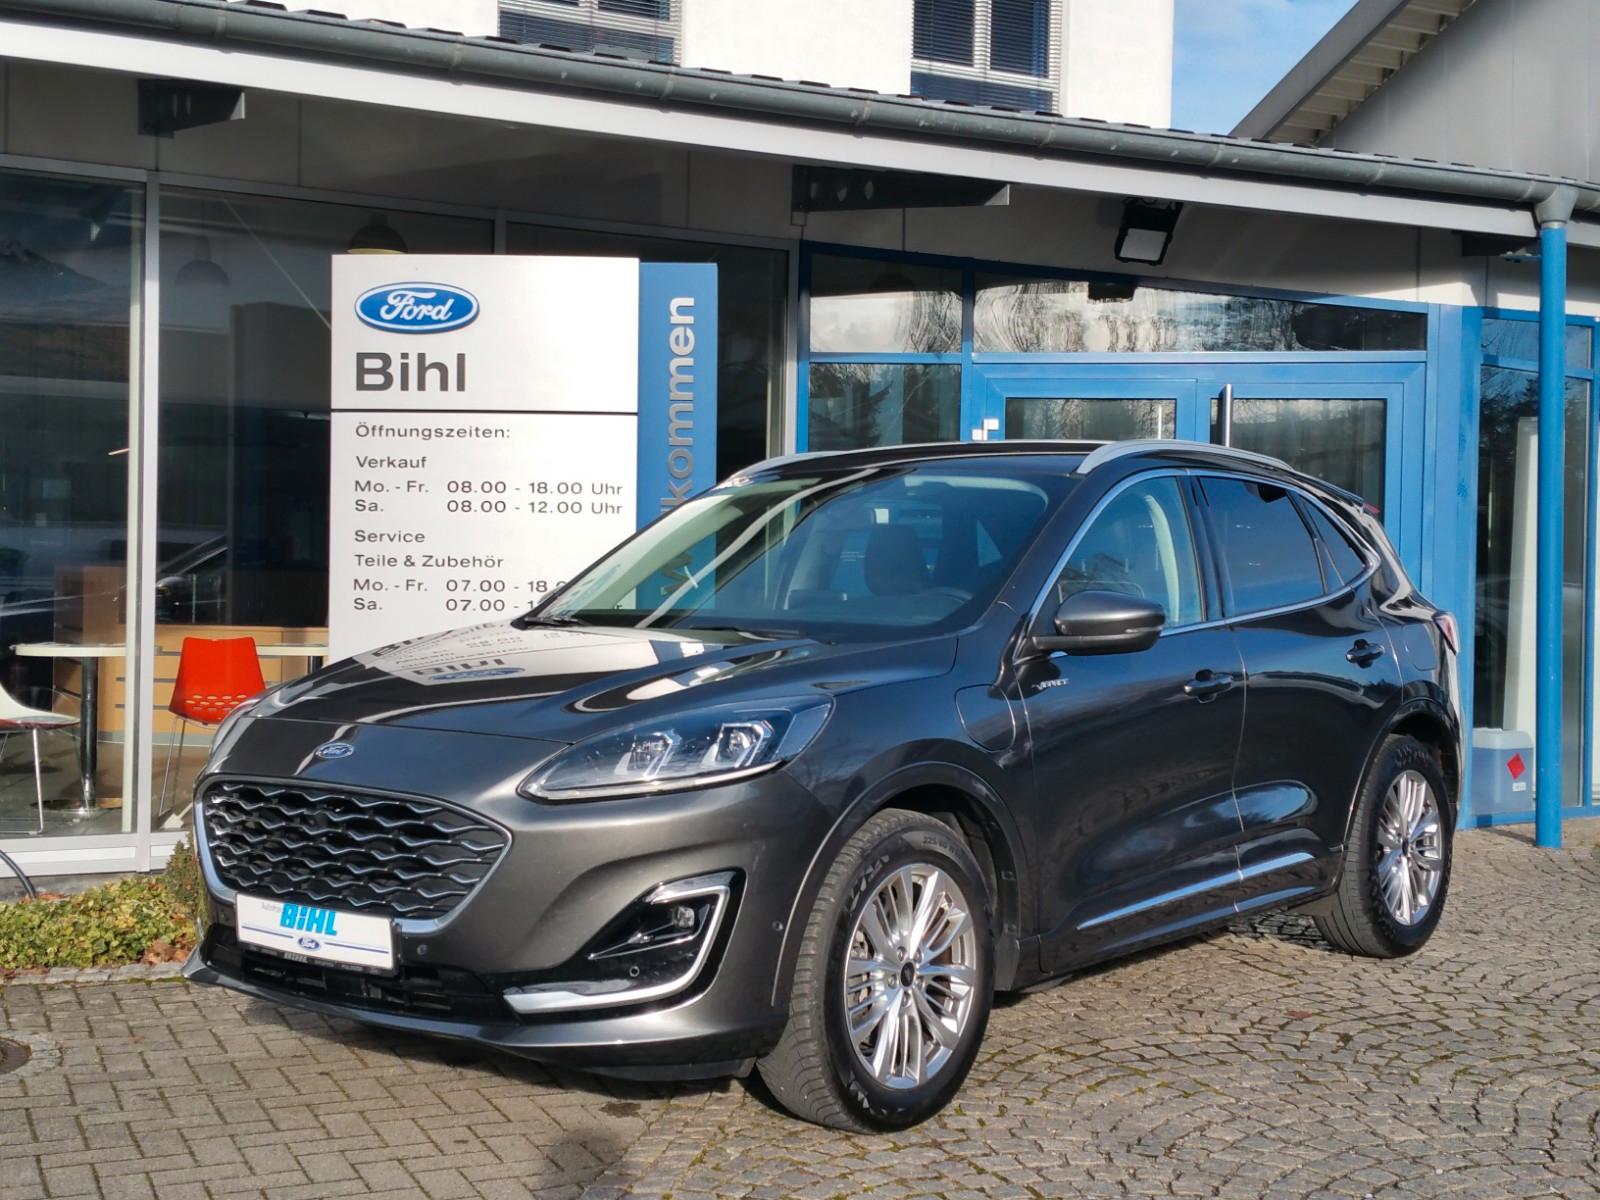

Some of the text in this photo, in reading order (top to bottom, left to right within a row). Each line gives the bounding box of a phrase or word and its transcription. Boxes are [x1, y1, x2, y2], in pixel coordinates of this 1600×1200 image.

[379, 289, 455, 322] Ford
[355, 351, 466, 392] Bihl
[355, 421, 511, 441] Öffnungszeiten:
[355, 455, 427, 469] Verkauf
[354, 479, 390, 493] Mo.
[406, 480, 430, 493] Fr.
[446, 480, 507, 494] 08.00
[528, 481, 583, 495] 18.00
[591, 482, 624, 496] Uhr
[354, 499, 385, 513] Sa.
[446, 500, 507, 514] 08.00
[528, 500, 583, 514] 12.00
[591, 502, 624, 515] Uhr
[354, 529, 426, 543] Service
[354, 553, 504, 569] Teile & Zubehör
[353, 578, 389, 592] Mo.
[405, 579, 428, 592] Fr.
[445, 580, 506, 593] 07.00
[353, 597, 383, 611] Sa.
[445, 598, 506, 612] 07.00
